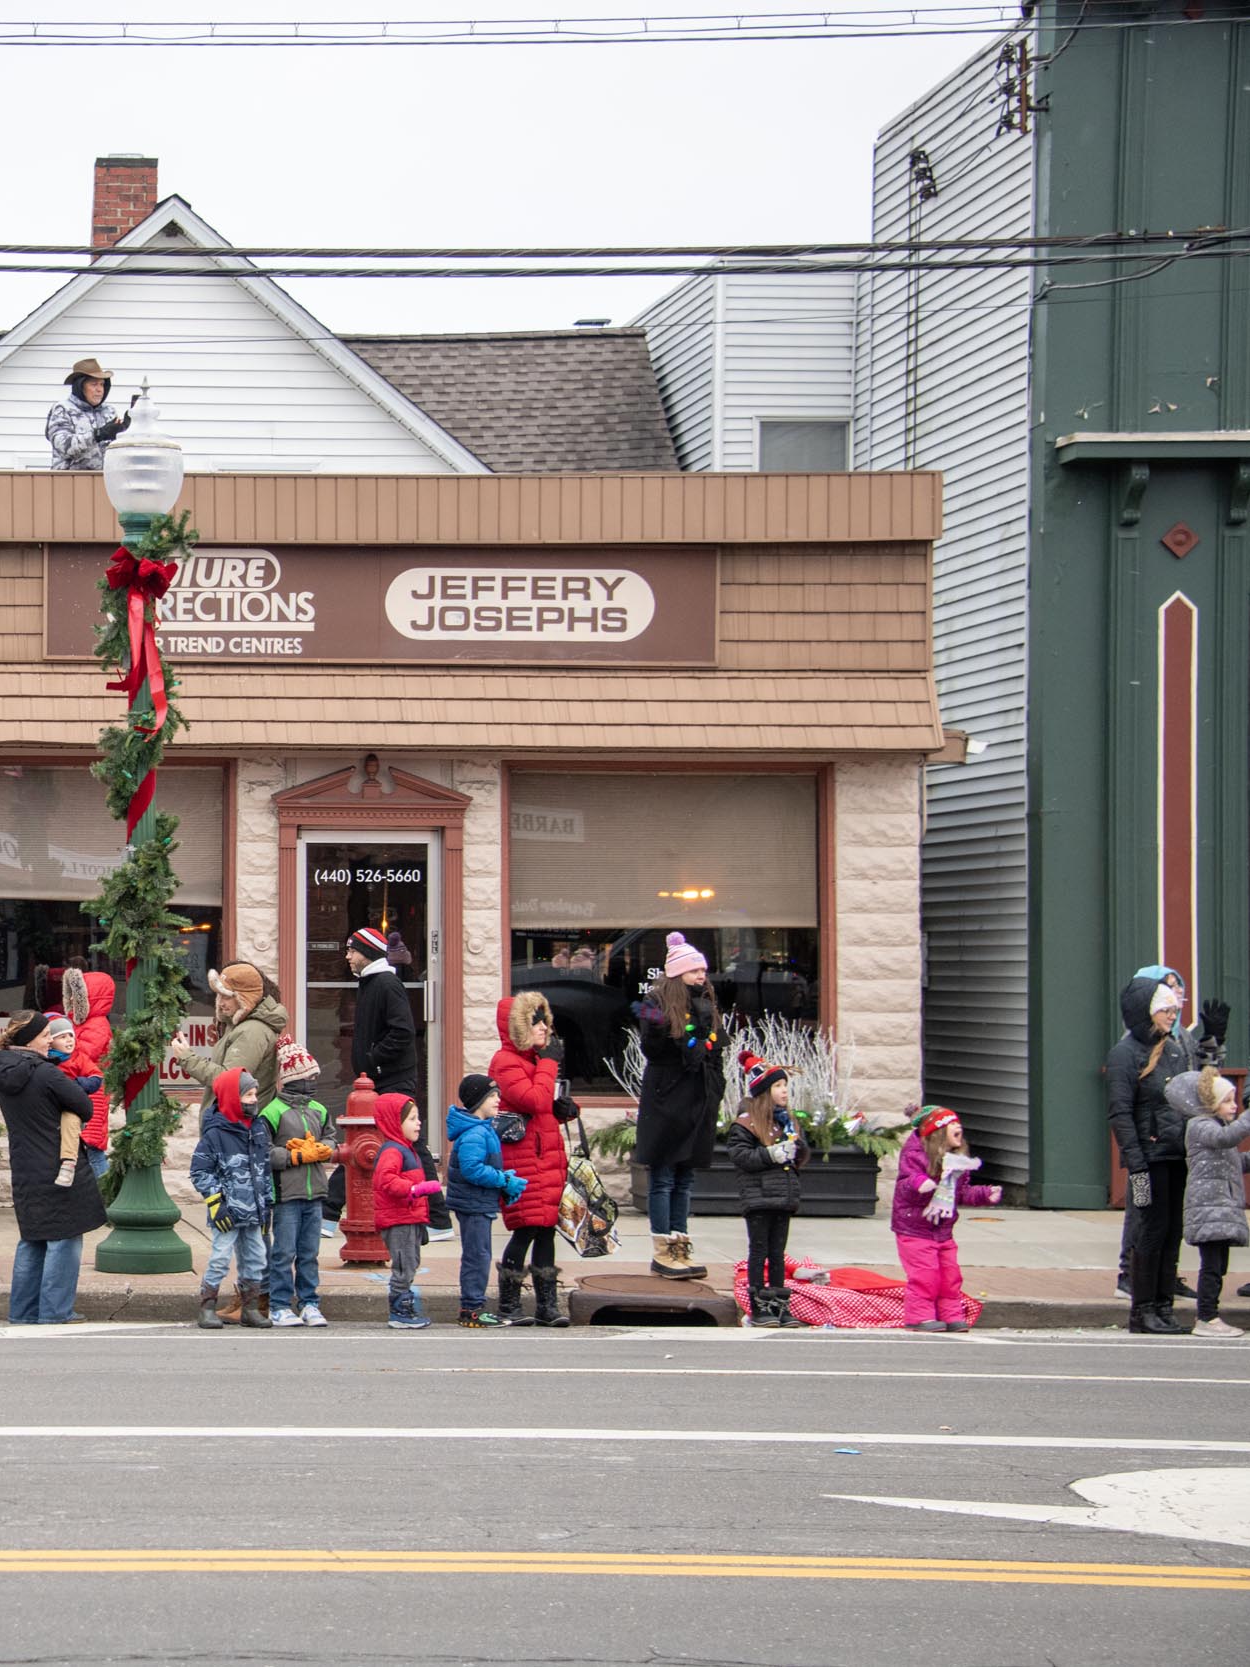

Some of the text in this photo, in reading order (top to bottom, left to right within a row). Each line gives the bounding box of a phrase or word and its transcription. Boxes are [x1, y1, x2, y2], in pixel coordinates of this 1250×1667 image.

[171, 557, 266, 588] TURE
[411, 576, 626, 600] JEFFERY
[156, 591, 316, 622] RECTIONS
[410, 606, 628, 633] JOSEPHS
[168, 637, 225, 653] TREND
[229, 638, 302, 654] CENTRES
[314, 869, 421, 885] (440) 526-5660
